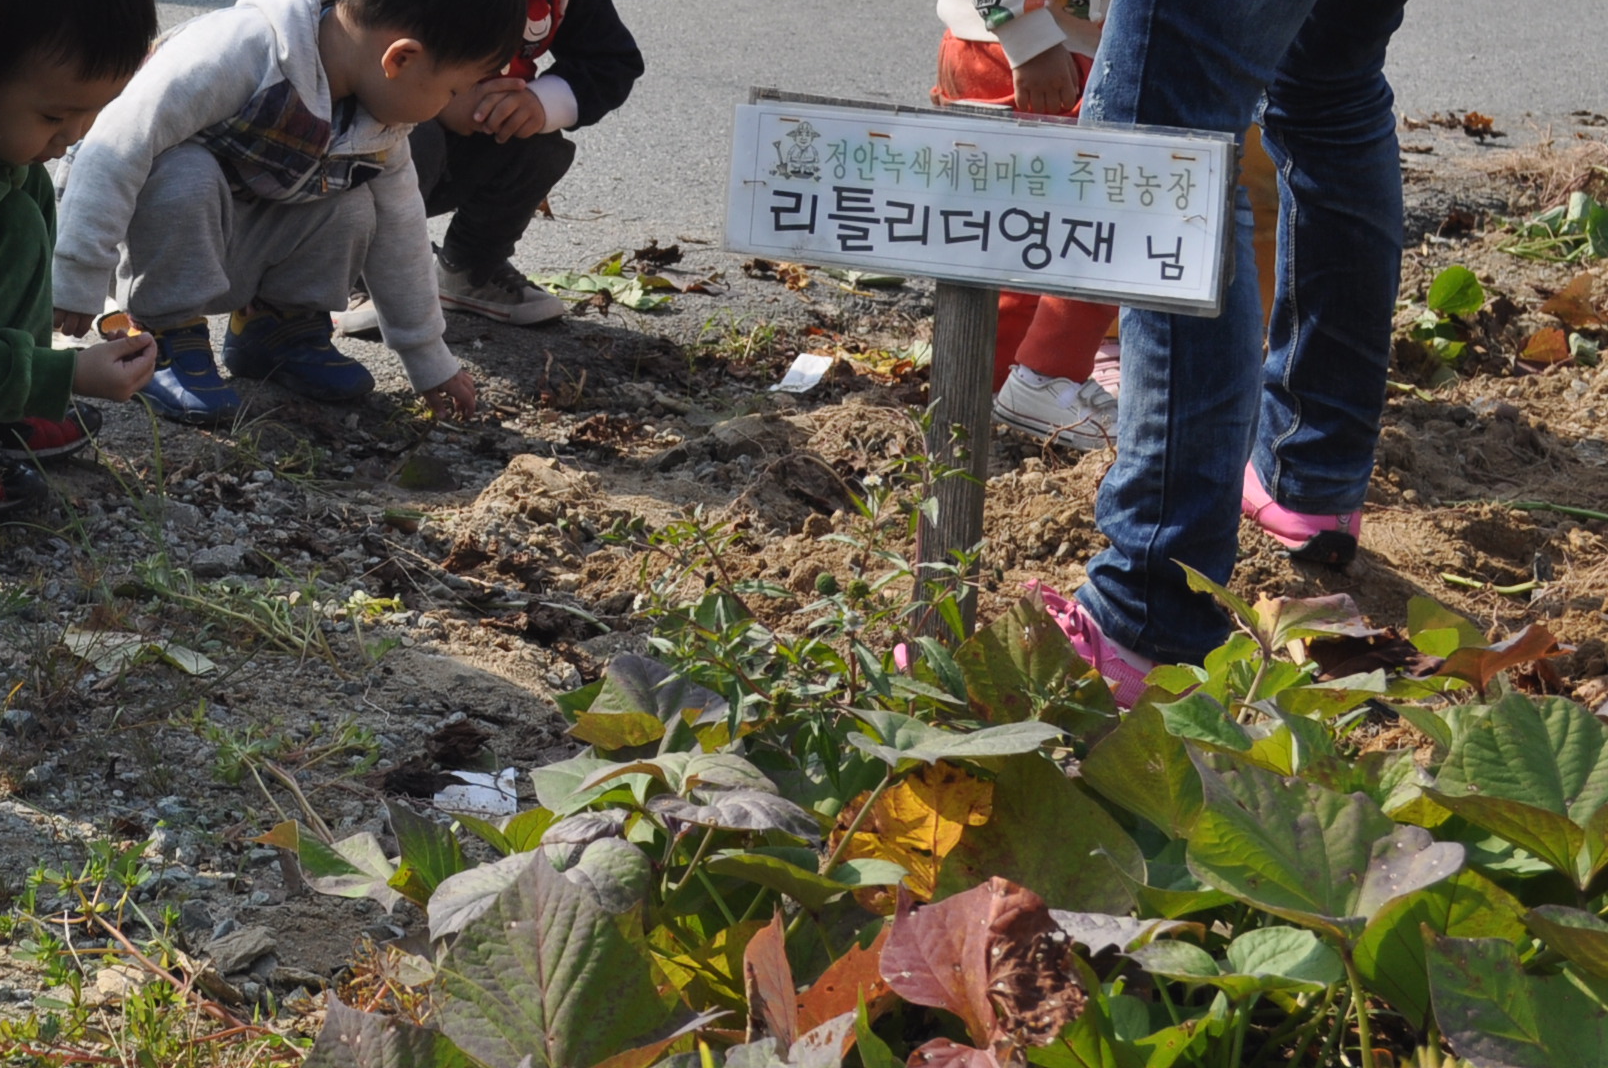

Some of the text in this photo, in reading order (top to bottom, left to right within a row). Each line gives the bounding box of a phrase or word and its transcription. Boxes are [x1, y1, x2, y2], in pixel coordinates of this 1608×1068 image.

[825, 139, 1196, 211] 정안녹색체험마을 주말농장
[770, 185, 1185, 281] 리틀리더영재 님
